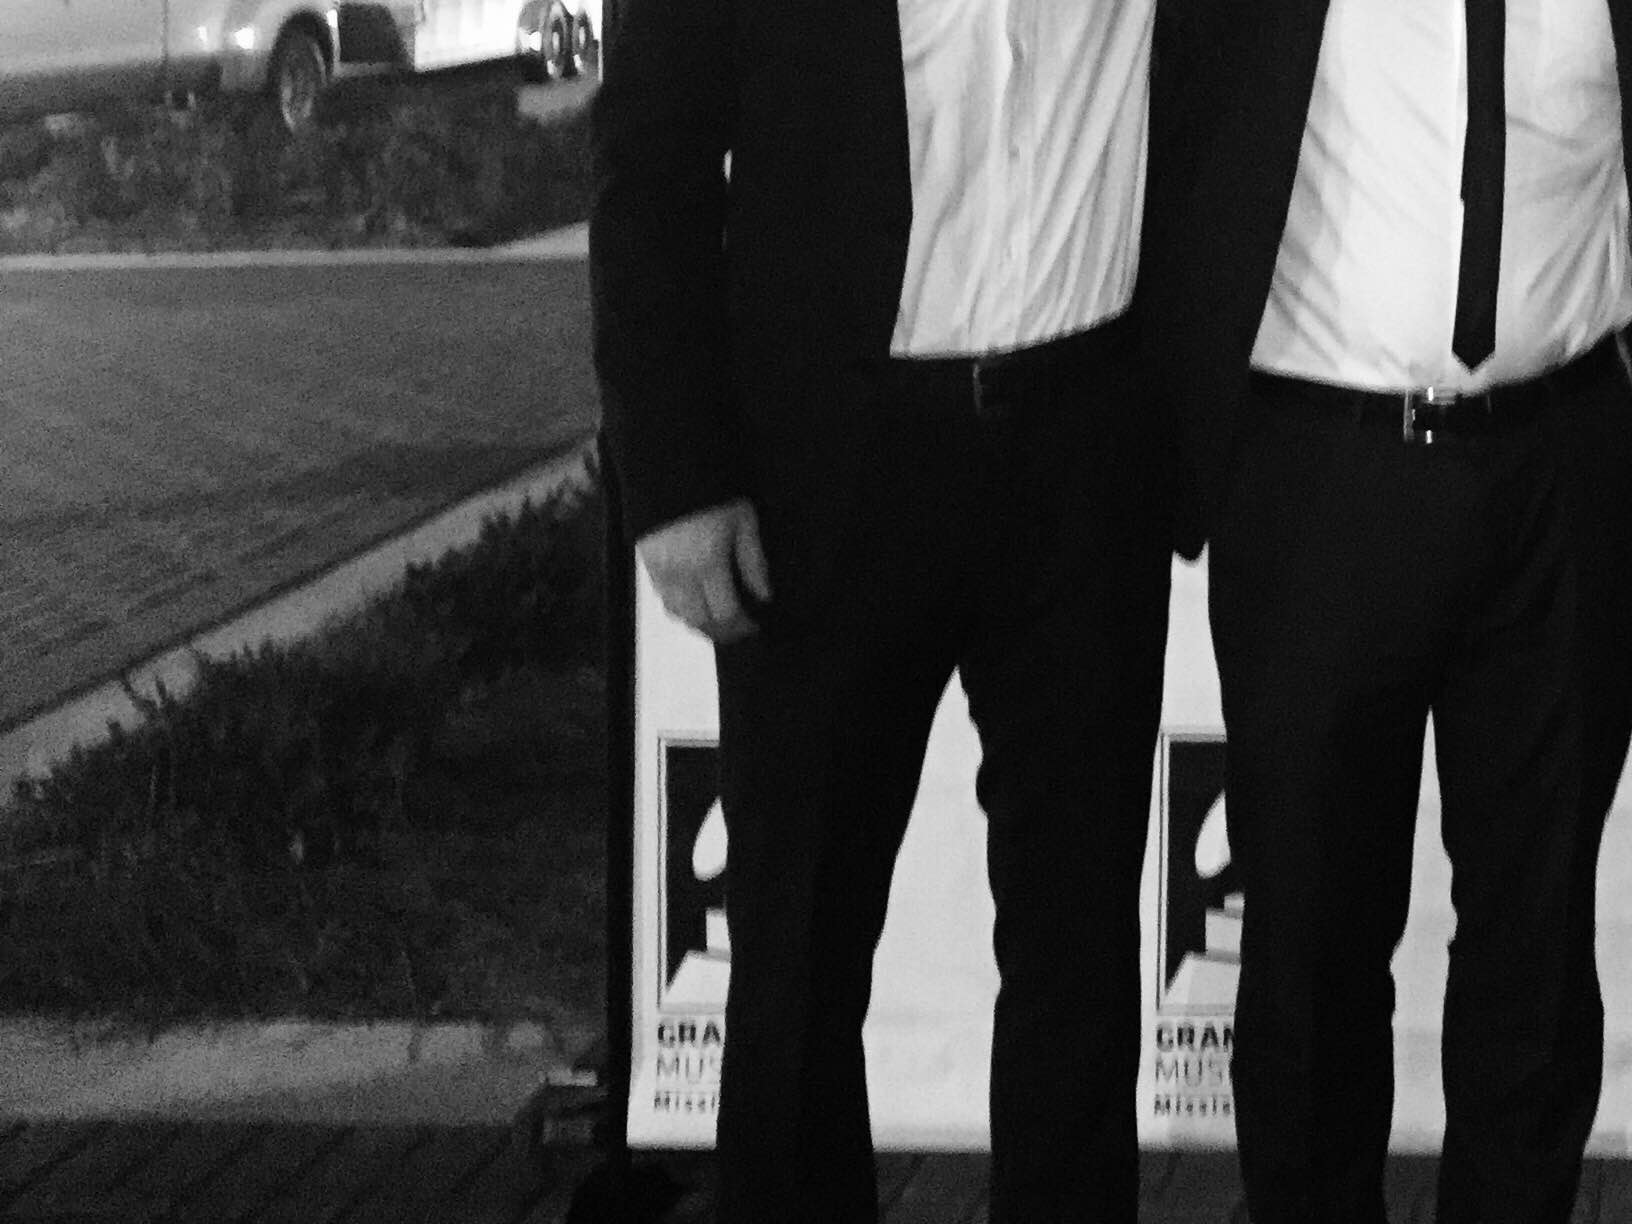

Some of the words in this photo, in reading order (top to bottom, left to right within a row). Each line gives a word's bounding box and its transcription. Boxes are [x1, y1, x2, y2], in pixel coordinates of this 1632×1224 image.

[656, 1023, 723, 1048] GRA
[656, 1055, 722, 1084] MUS
[1155, 1058, 1226, 1088] MUS
